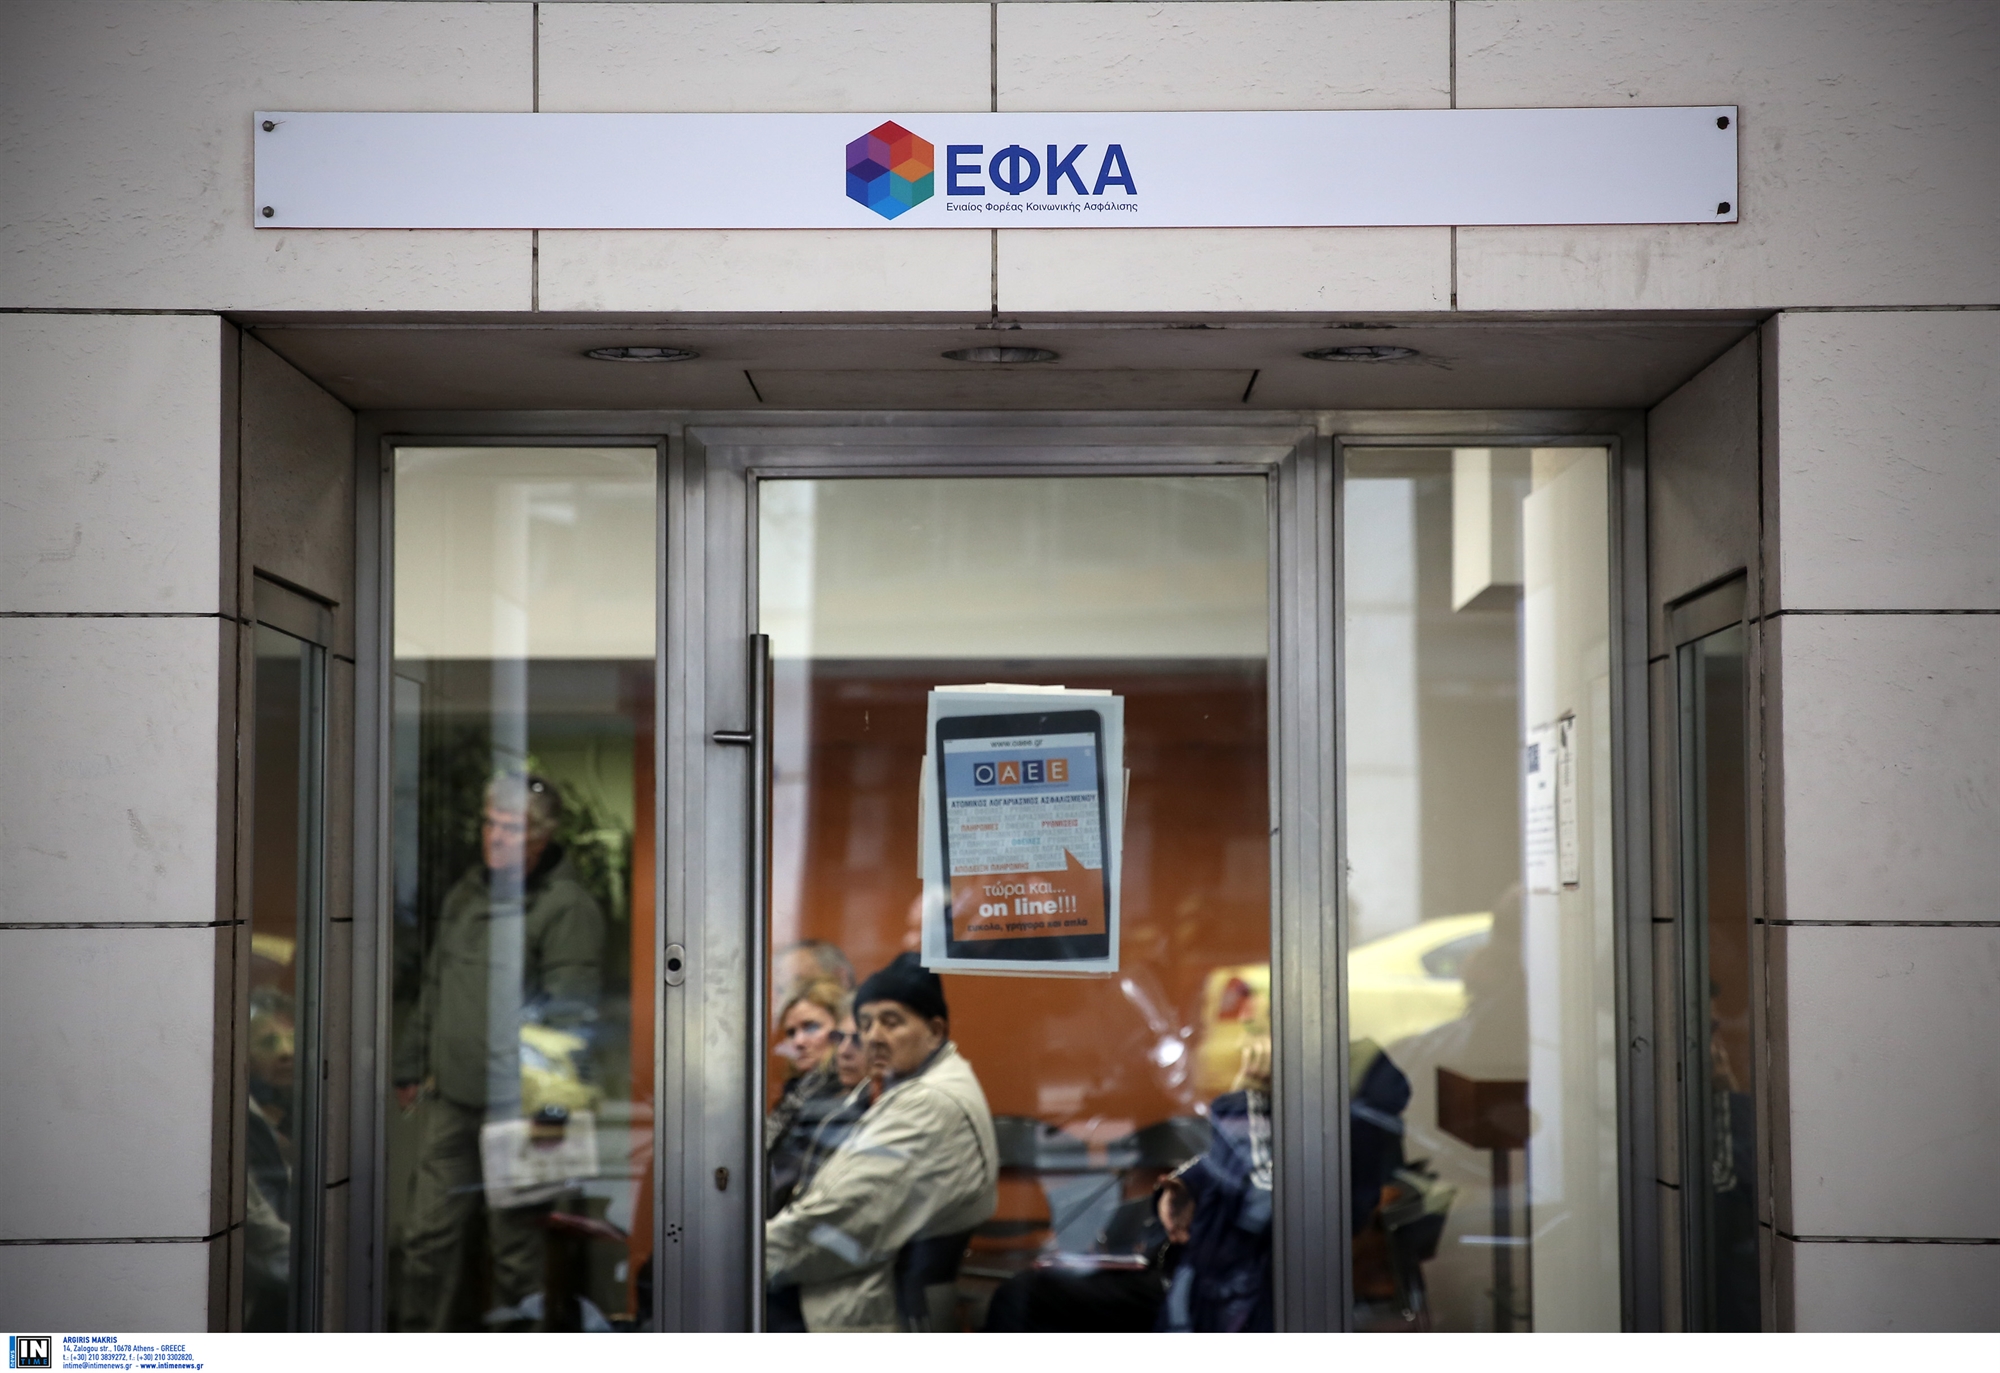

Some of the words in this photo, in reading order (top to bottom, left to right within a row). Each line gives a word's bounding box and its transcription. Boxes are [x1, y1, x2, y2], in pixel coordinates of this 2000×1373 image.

[946, 144, 1138, 196] ΕΦΚΑ
[946, 202, 983, 213] Ενιαίος
[985, 202, 1024, 213] Φορέας
[1026, 202, 1081, 213] Κοινωνικής
[1083, 202, 1138, 213] Ασφάλισης
[990, 738, 1043, 749] www.oaee.gr
[982, 881, 1025, 899] τώρα
[978, 902, 1008, 918] on
[1014, 895, 1077, 916] line!!!
